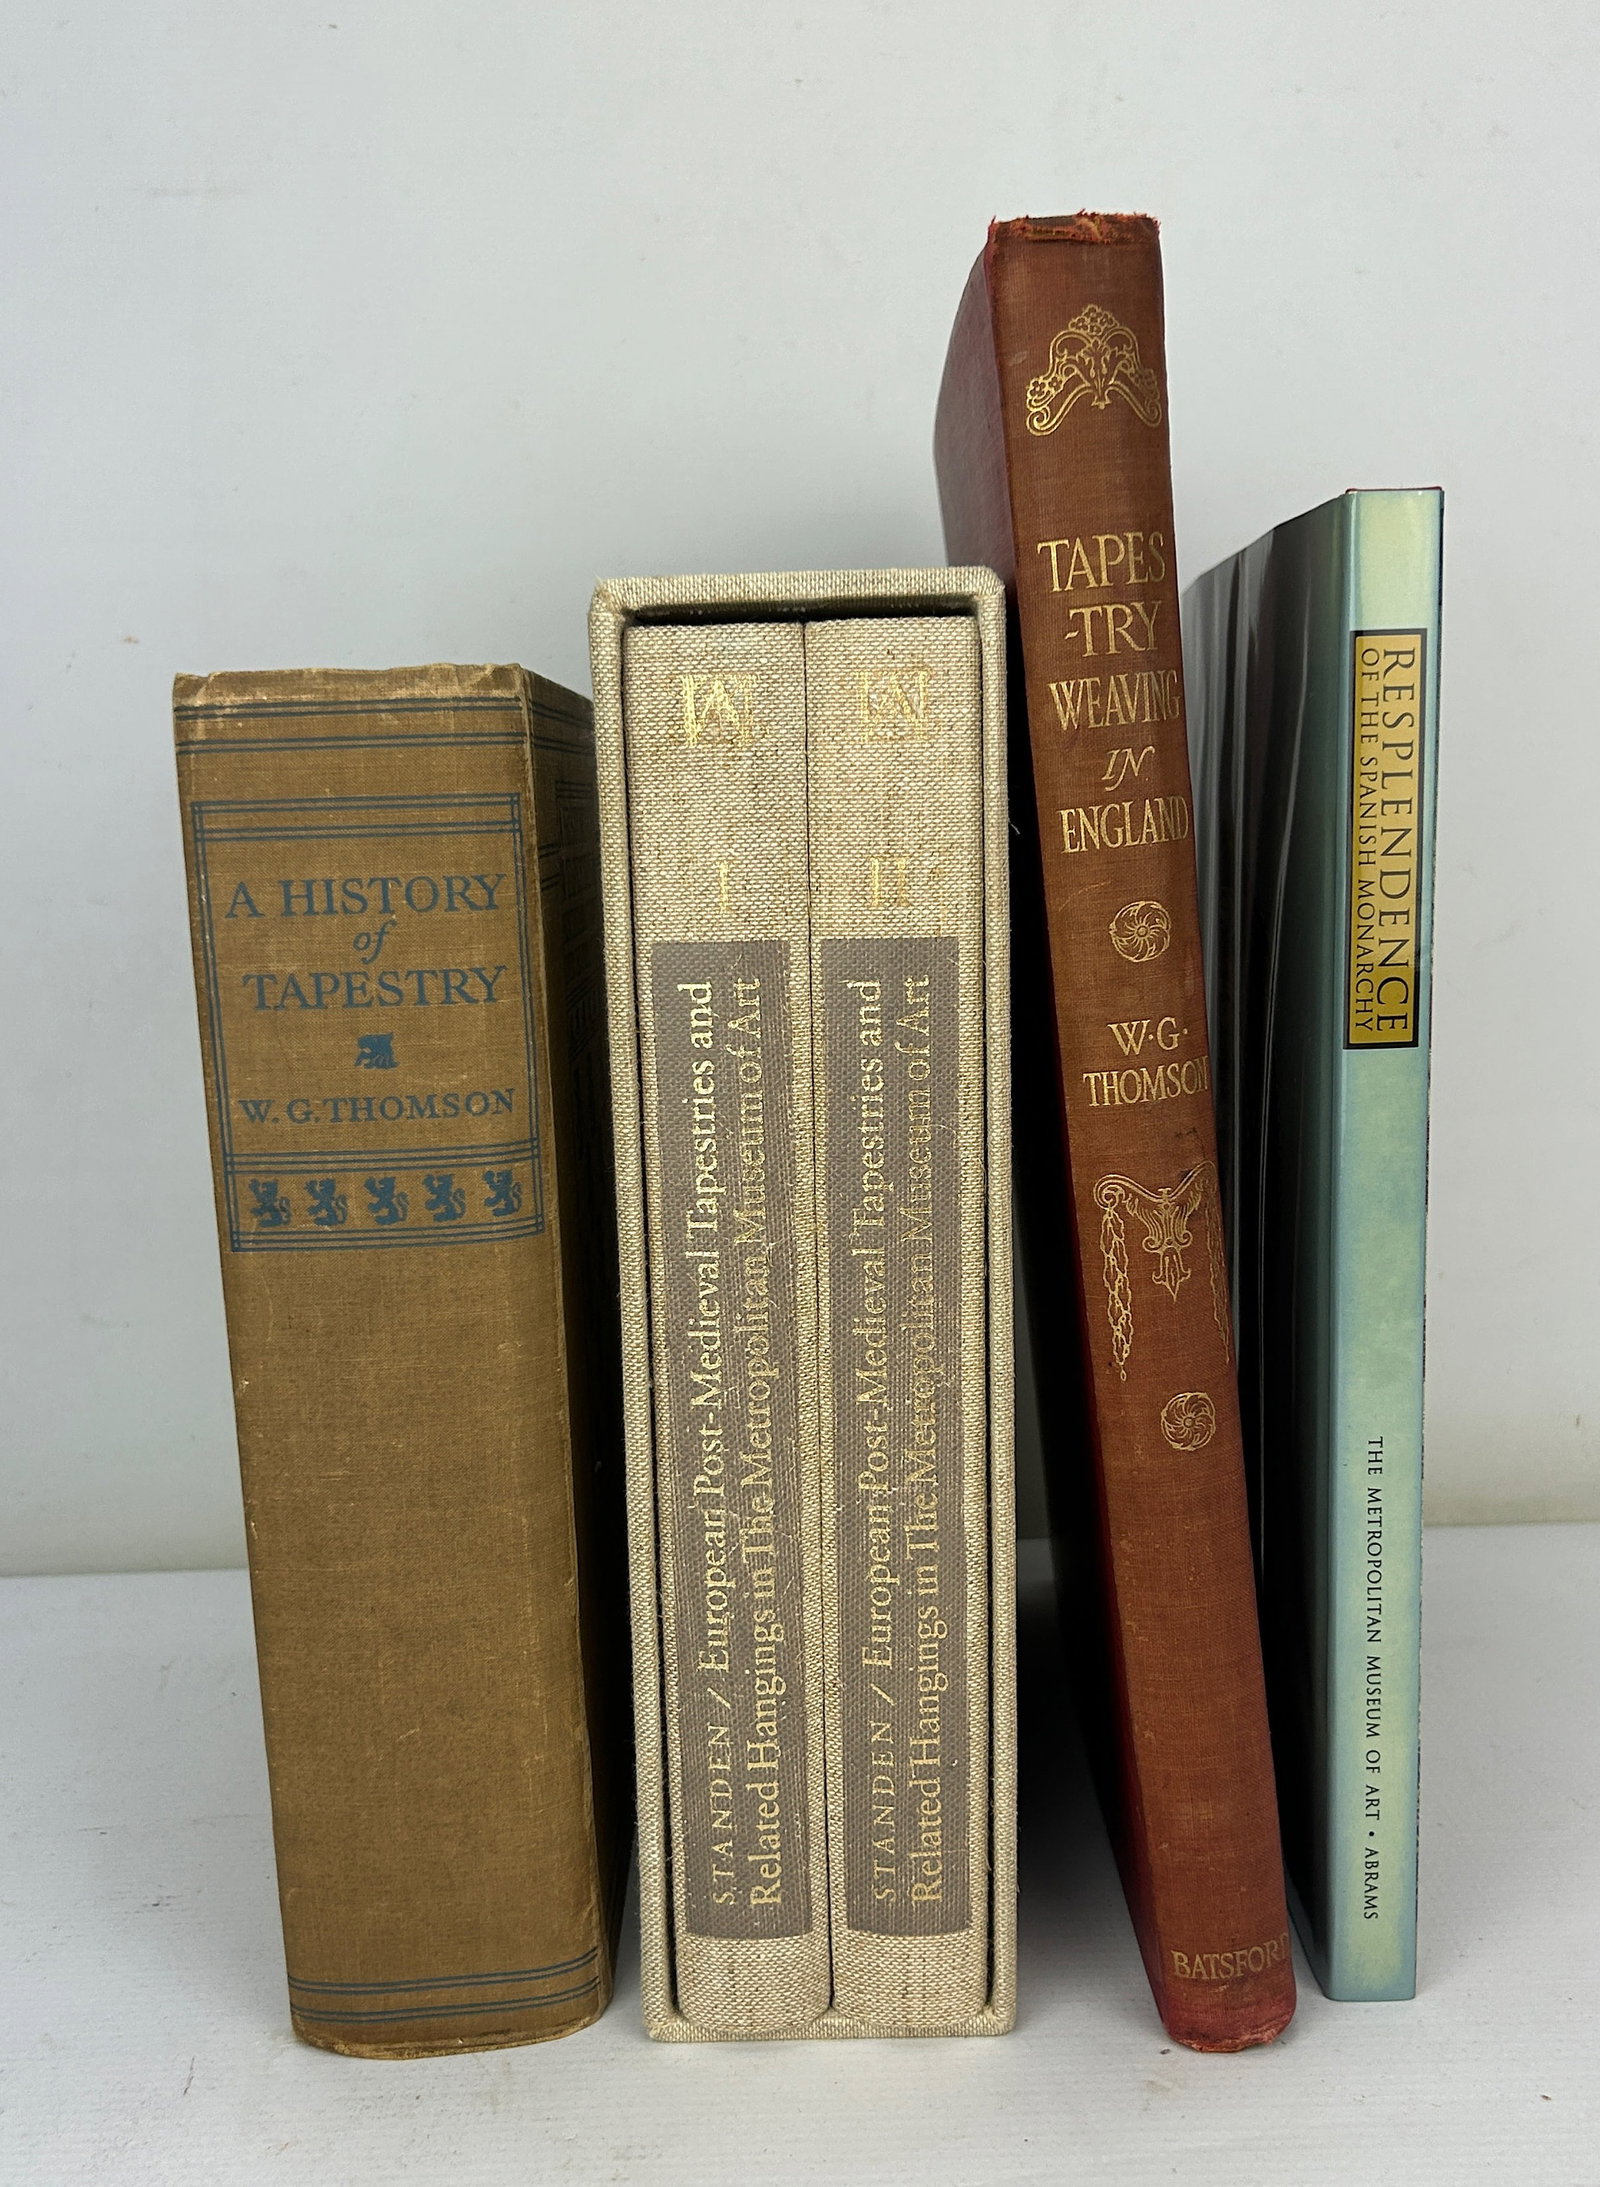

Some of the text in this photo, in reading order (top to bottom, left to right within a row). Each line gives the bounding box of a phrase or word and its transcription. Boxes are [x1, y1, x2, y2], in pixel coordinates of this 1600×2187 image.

[1037, 531, 1167, 593] TAPES
[1048, 669, 1180, 732] WEAVING
[1101, 746, 1155, 793] IN
[225, 874, 508, 919] A HISTORY
[1056, 795, 1190, 855] ENGLAND
[1355, 647, 1380, 1032] OF THE SPANISH MONARCHY
[1376, 647, 1416, 1032] RESPLENDENCE
[242, 964, 509, 1012] TAPESTRY
[352, 919, 398, 965] of
[677, 980, 714, 1050] and
[846, 979, 882, 1047] and
[681, 1058, 727, 1240] Tapestries
[849, 1057, 895, 1240] Tapestries
[1082, 1055, 1209, 1107] THOMSON
[686, 1250, 725, 1497] Post-Medieval
[725, 976, 787, 1905] Related Hangings in The Metropolitan Museum of Art
[851, 1248, 890, 1492] Post-Medieval
[894, 974, 948, 1904] Related Hangings in The Metropolitan Museum of Art
[697, 1507, 737, 1673] European
[861, 1503, 900, 1670] European
[1363, 1436, 1384, 1920] THE METROPOLITAN MUSEUM OF ART ABRAMS
[707, 1722, 735, 1906] STANDEN
[870, 1719, 896, 1904] STANDEN
